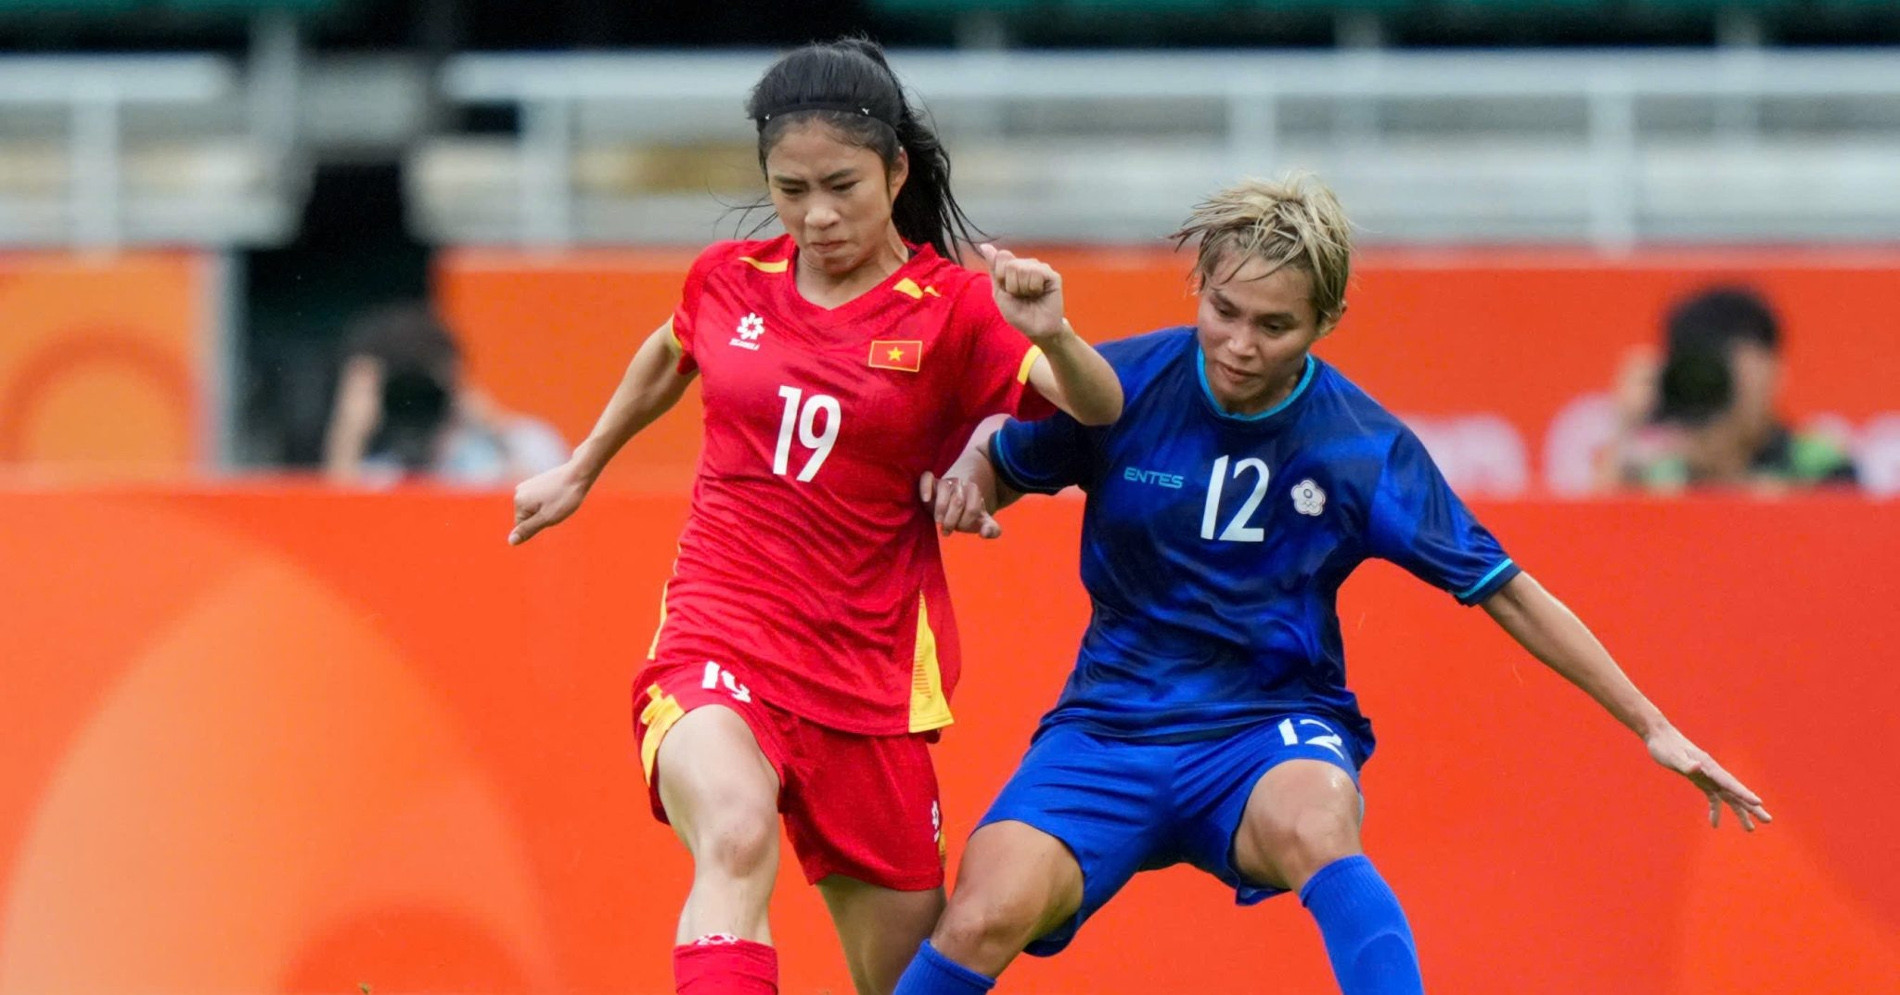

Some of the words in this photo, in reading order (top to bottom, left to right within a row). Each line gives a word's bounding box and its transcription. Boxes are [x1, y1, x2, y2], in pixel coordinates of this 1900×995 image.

[772, 385, 842, 483] 19
[1123, 466, 1185, 489] ENTES
[1200, 454, 1270, 542] 12
[1278, 718, 1344, 760] 12
